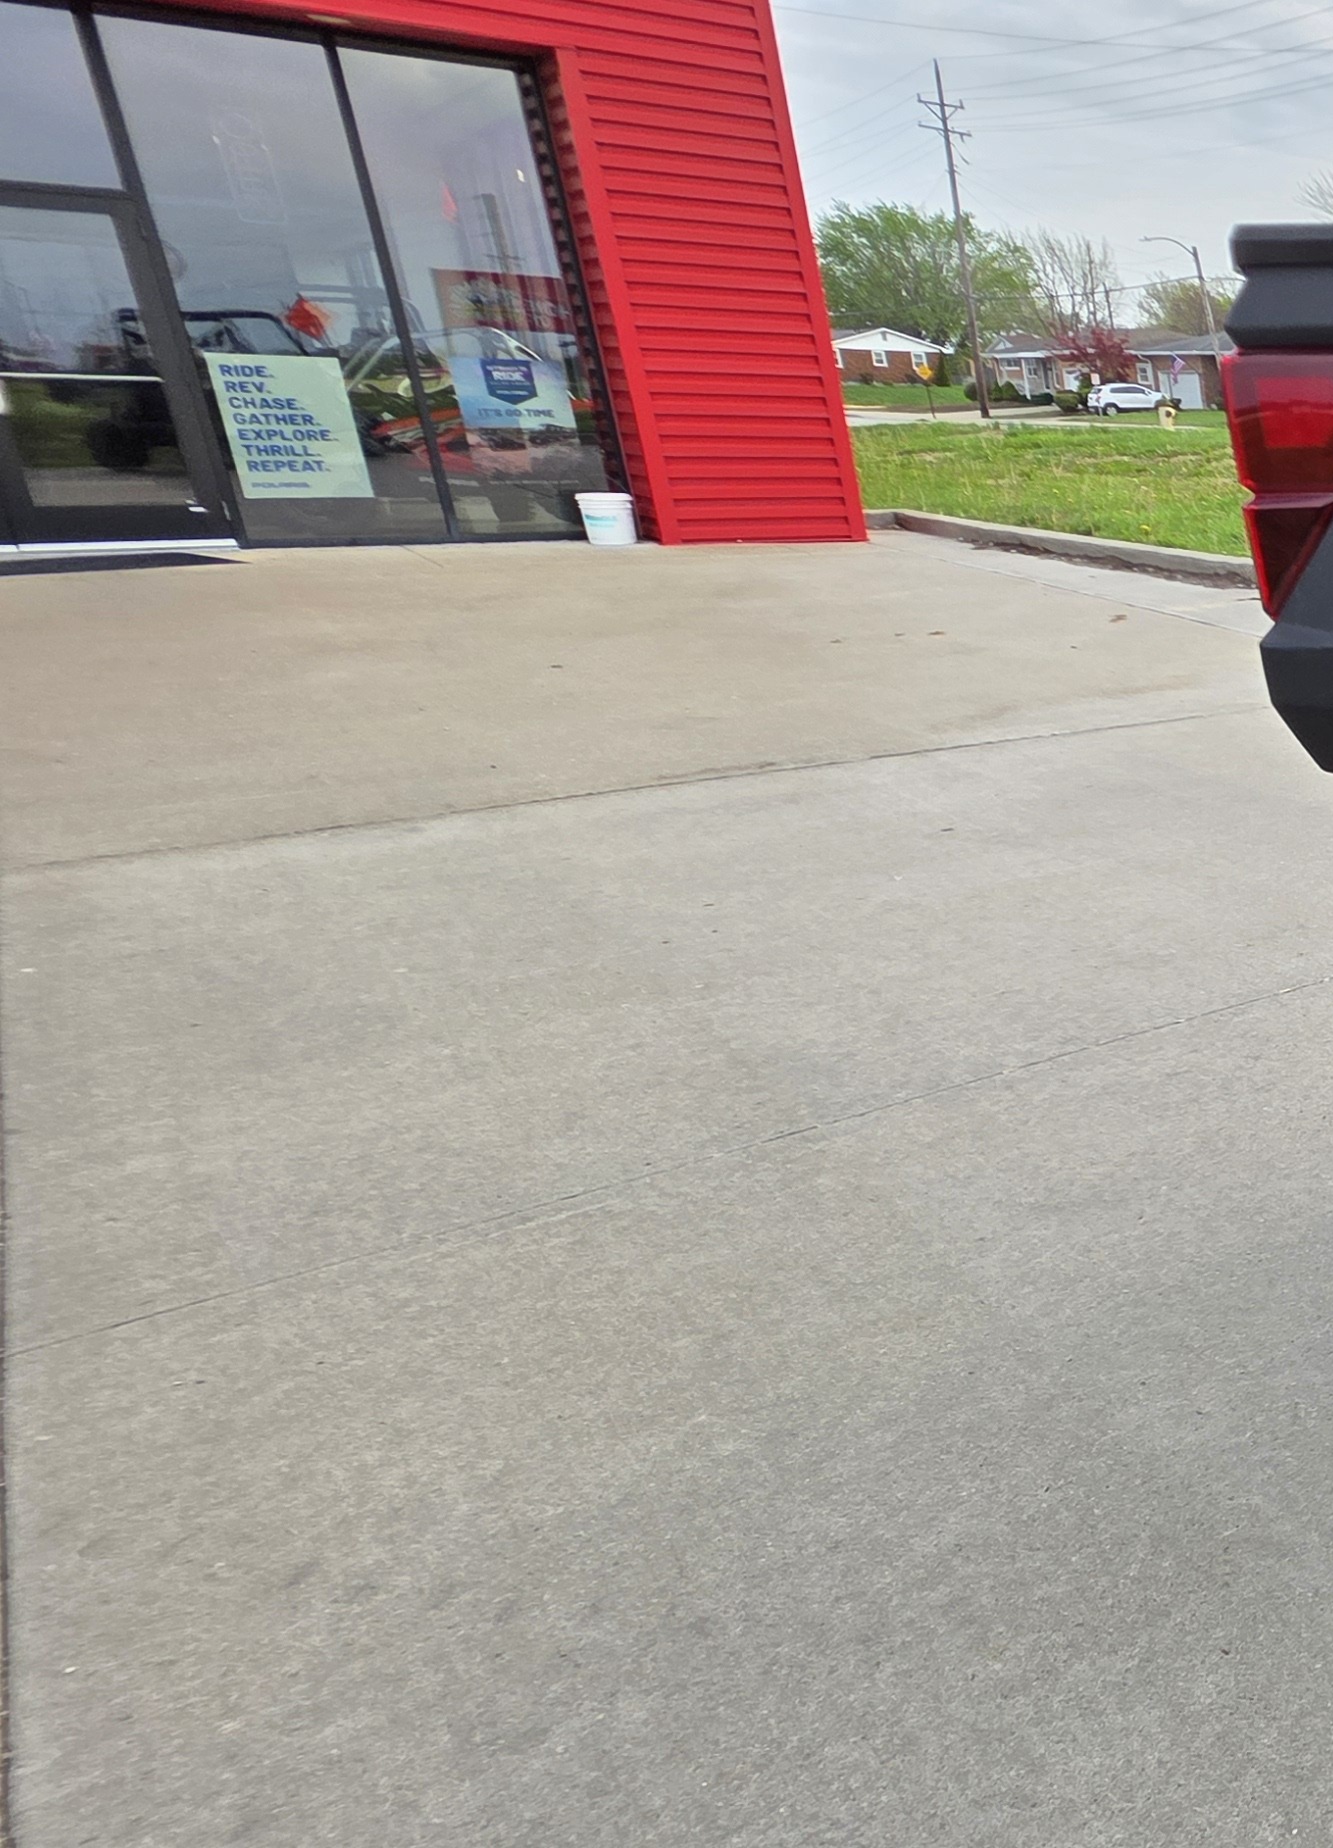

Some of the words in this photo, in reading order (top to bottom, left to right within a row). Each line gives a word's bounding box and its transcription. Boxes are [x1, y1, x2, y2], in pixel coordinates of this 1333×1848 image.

[218, 364, 275, 378] RIDE.
[223, 381, 272, 394] REV.
[228, 396, 306, 410] CHASE.
[232, 413, 322, 426] GATHER.
[237, 428, 339, 442] EXPLORE.
[241, 444, 322, 457] THRILL.
[246, 460, 332, 472] REPEAT.
